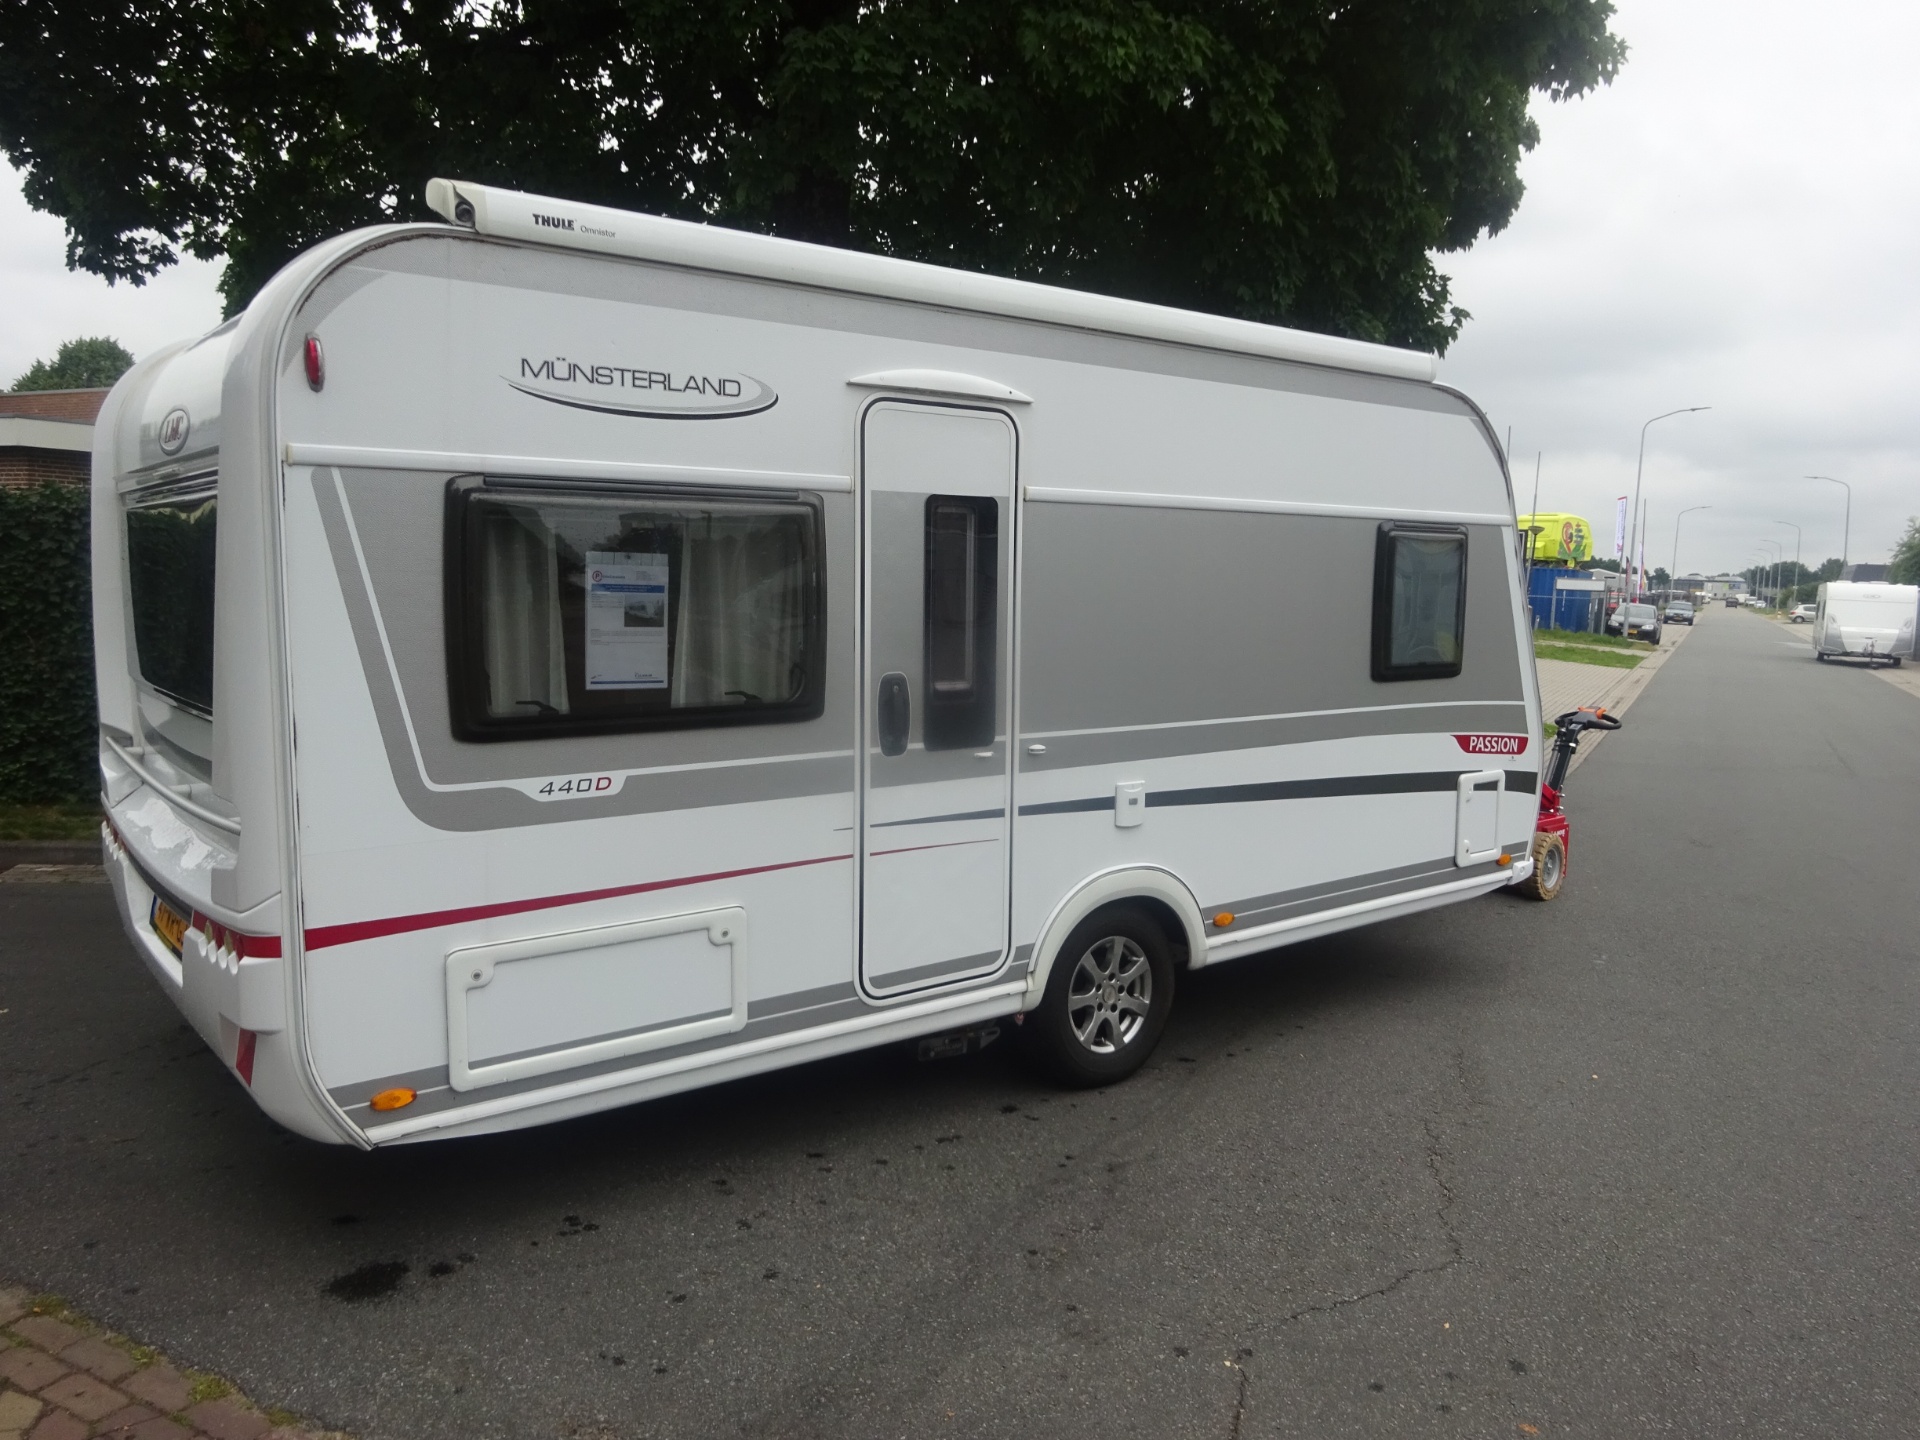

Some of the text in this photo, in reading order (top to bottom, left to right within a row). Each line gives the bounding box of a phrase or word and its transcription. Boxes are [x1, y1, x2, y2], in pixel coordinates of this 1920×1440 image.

[532, 213, 616, 238] THULE Omnistor
[521, 357, 741, 397] MÜNSTERLAND
[164, 415, 184, 444] LMC
[1469, 736, 1518, 752] PASSION
[539, 777, 612, 795] 440D
